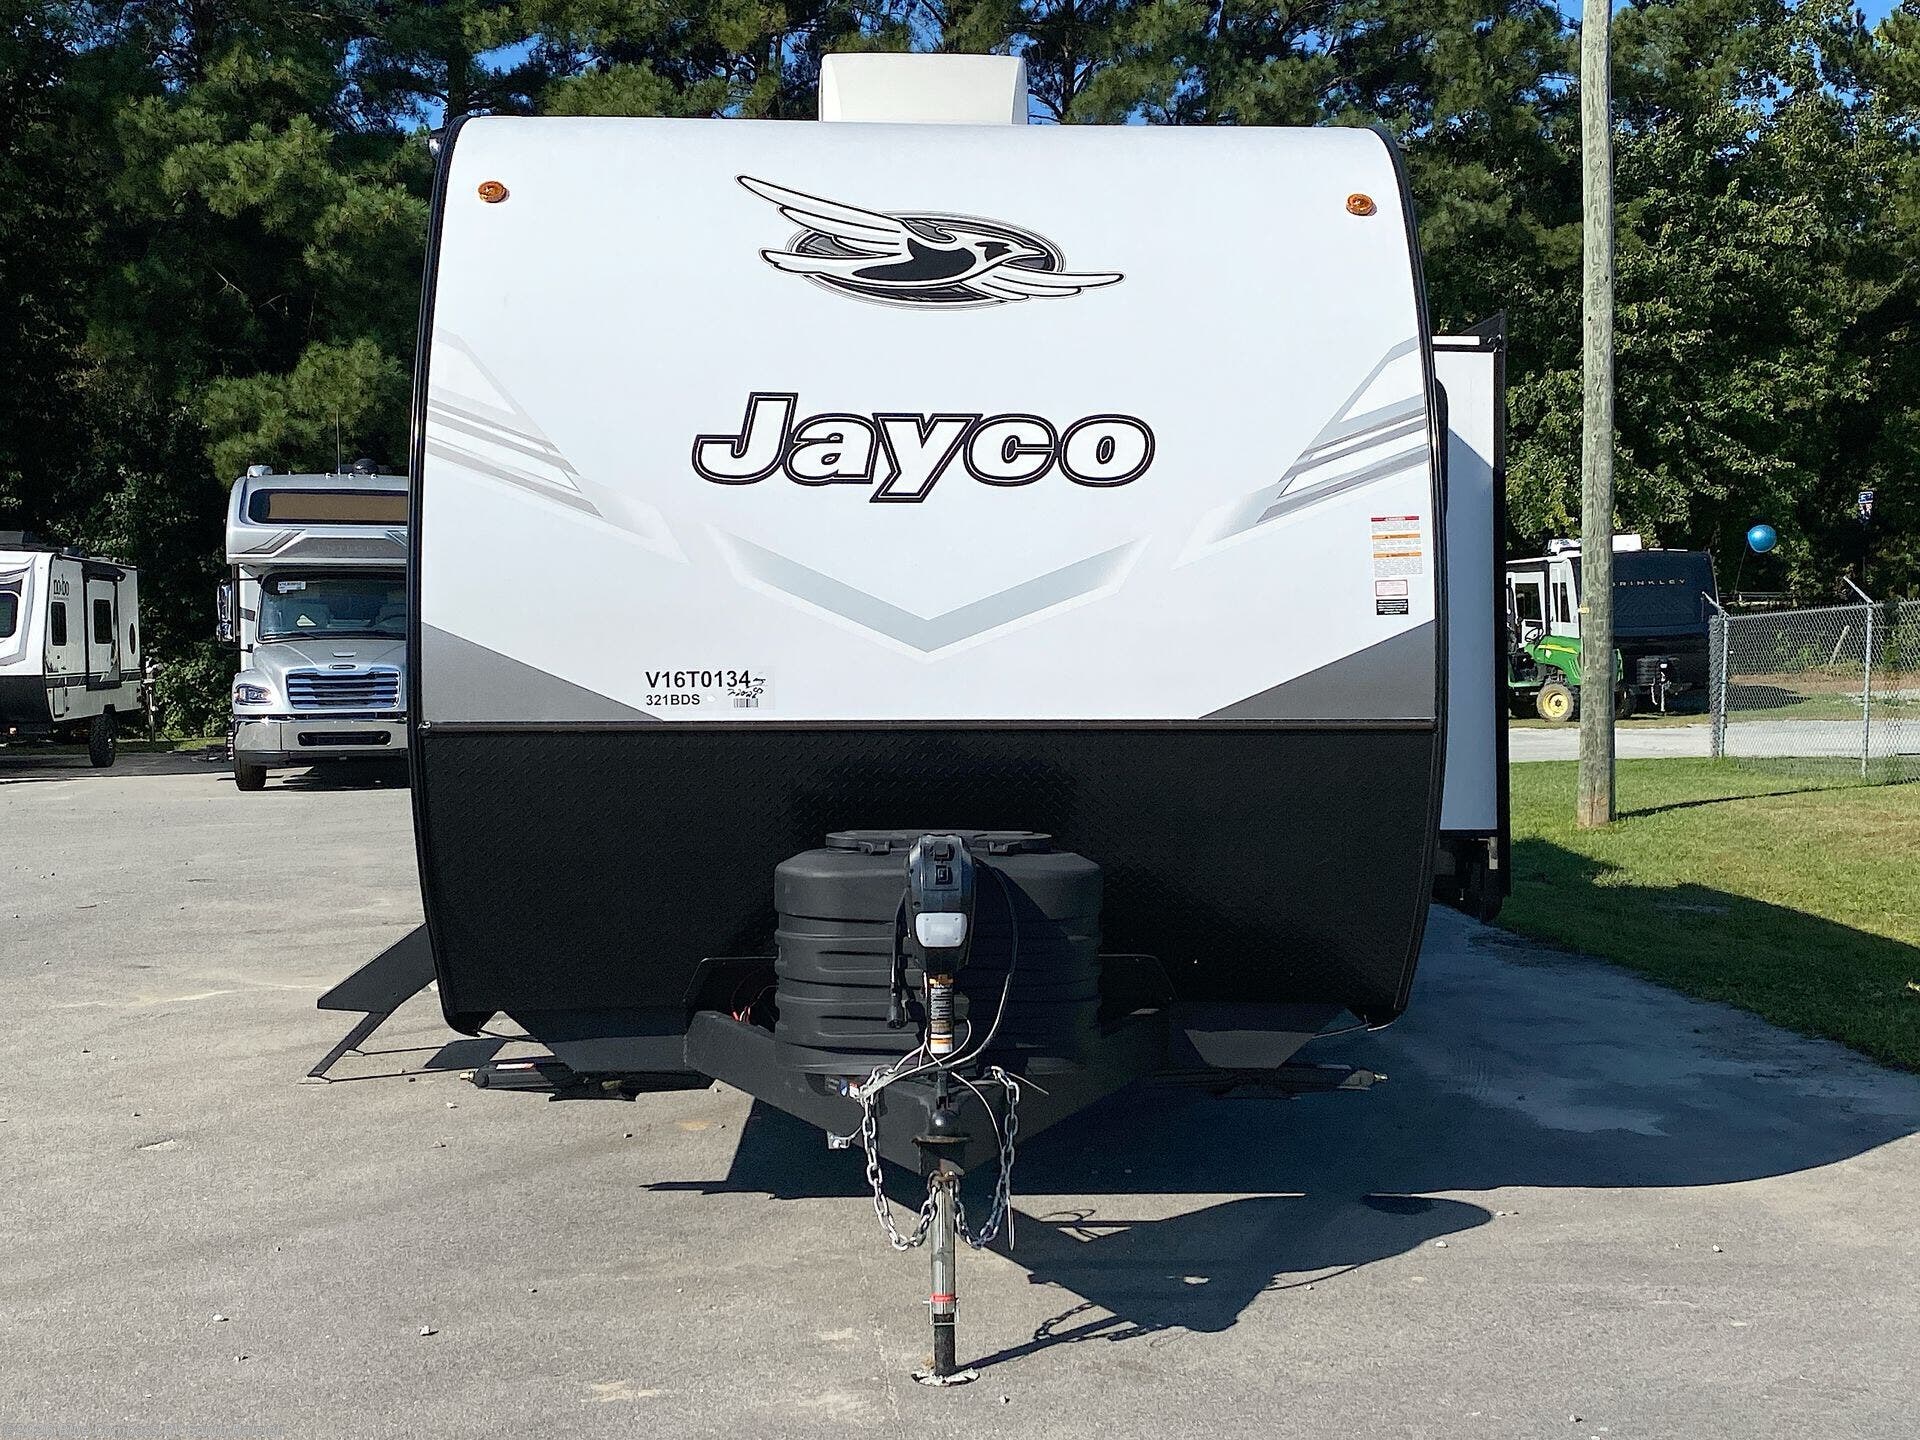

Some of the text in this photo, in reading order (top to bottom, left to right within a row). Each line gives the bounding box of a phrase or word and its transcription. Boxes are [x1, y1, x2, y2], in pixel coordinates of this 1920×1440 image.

[691, 392, 1155, 503] Jayco
[645, 670, 751, 688] V16T0134
[646, 694, 700, 706] 321BDS
